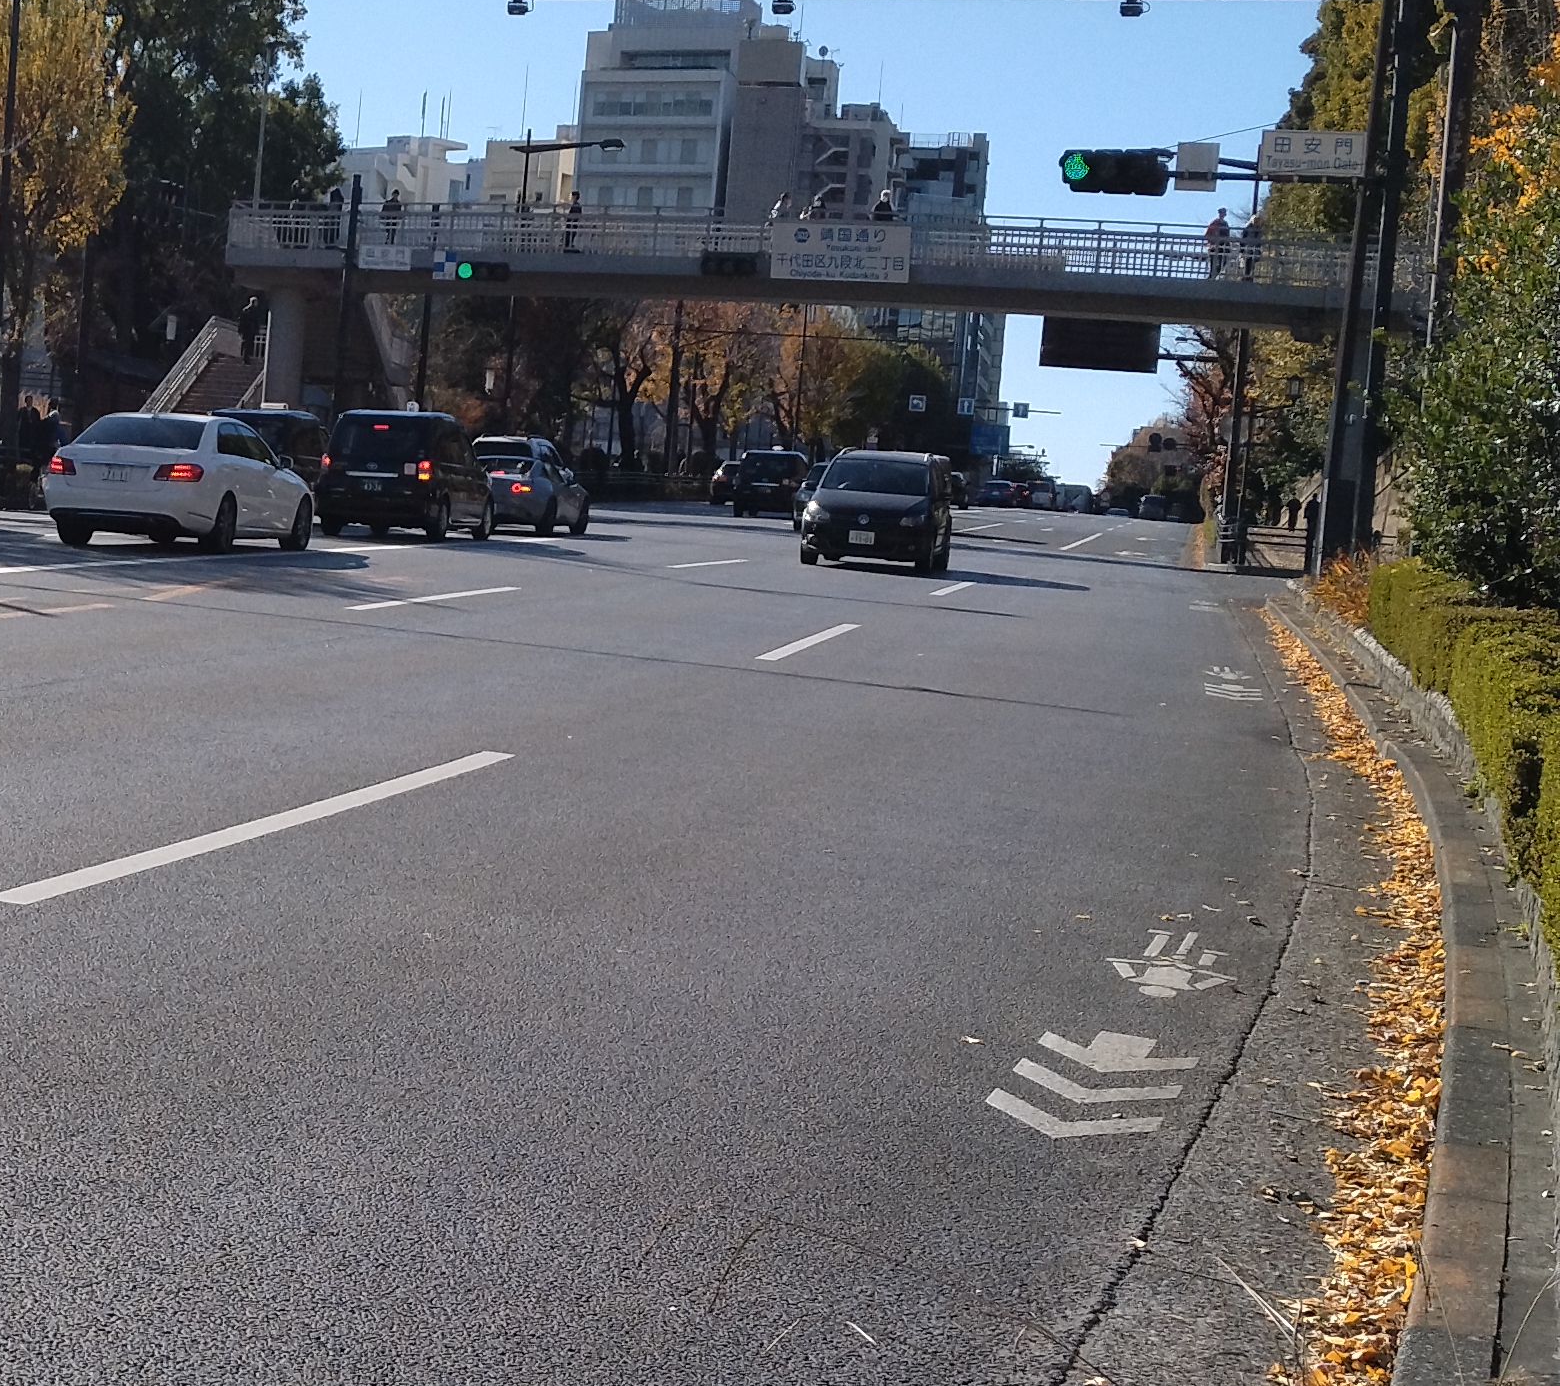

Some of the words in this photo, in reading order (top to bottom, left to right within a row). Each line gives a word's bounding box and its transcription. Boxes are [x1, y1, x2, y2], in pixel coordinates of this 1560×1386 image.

[1274, 137, 1353, 155] 田安門
[1266, 154, 1330, 170] Tayasu-mon
[1333, 157, 1359, 170] Gate
[776, 253, 904, 271] 千代田区九段北二丁目
